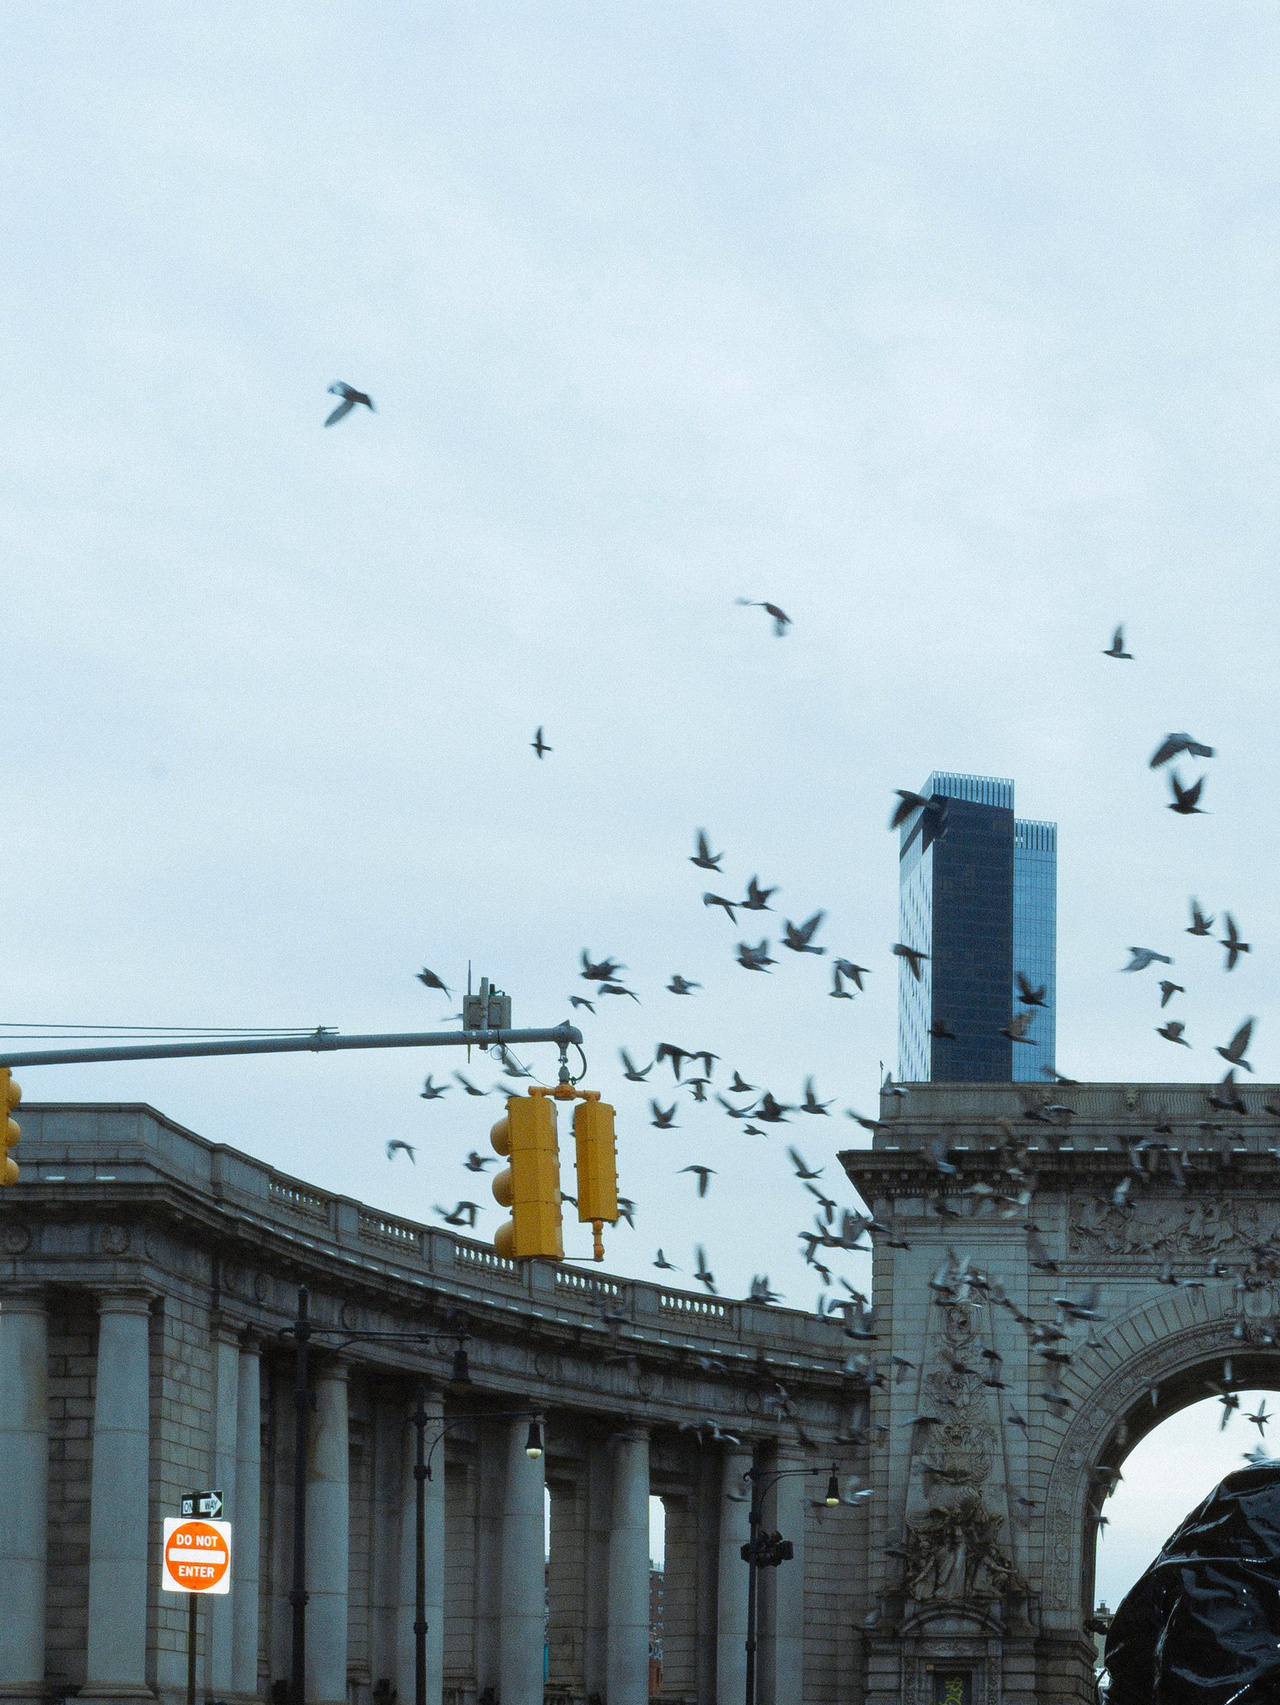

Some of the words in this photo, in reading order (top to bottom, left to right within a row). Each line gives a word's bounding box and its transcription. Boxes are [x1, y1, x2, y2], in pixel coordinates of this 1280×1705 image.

[205, 1500, 218, 1511] WAY
[176, 1533, 192, 1546] DO
[196, 1535, 218, 1548] NOT
[178, 1565, 215, 1578] ENTER
